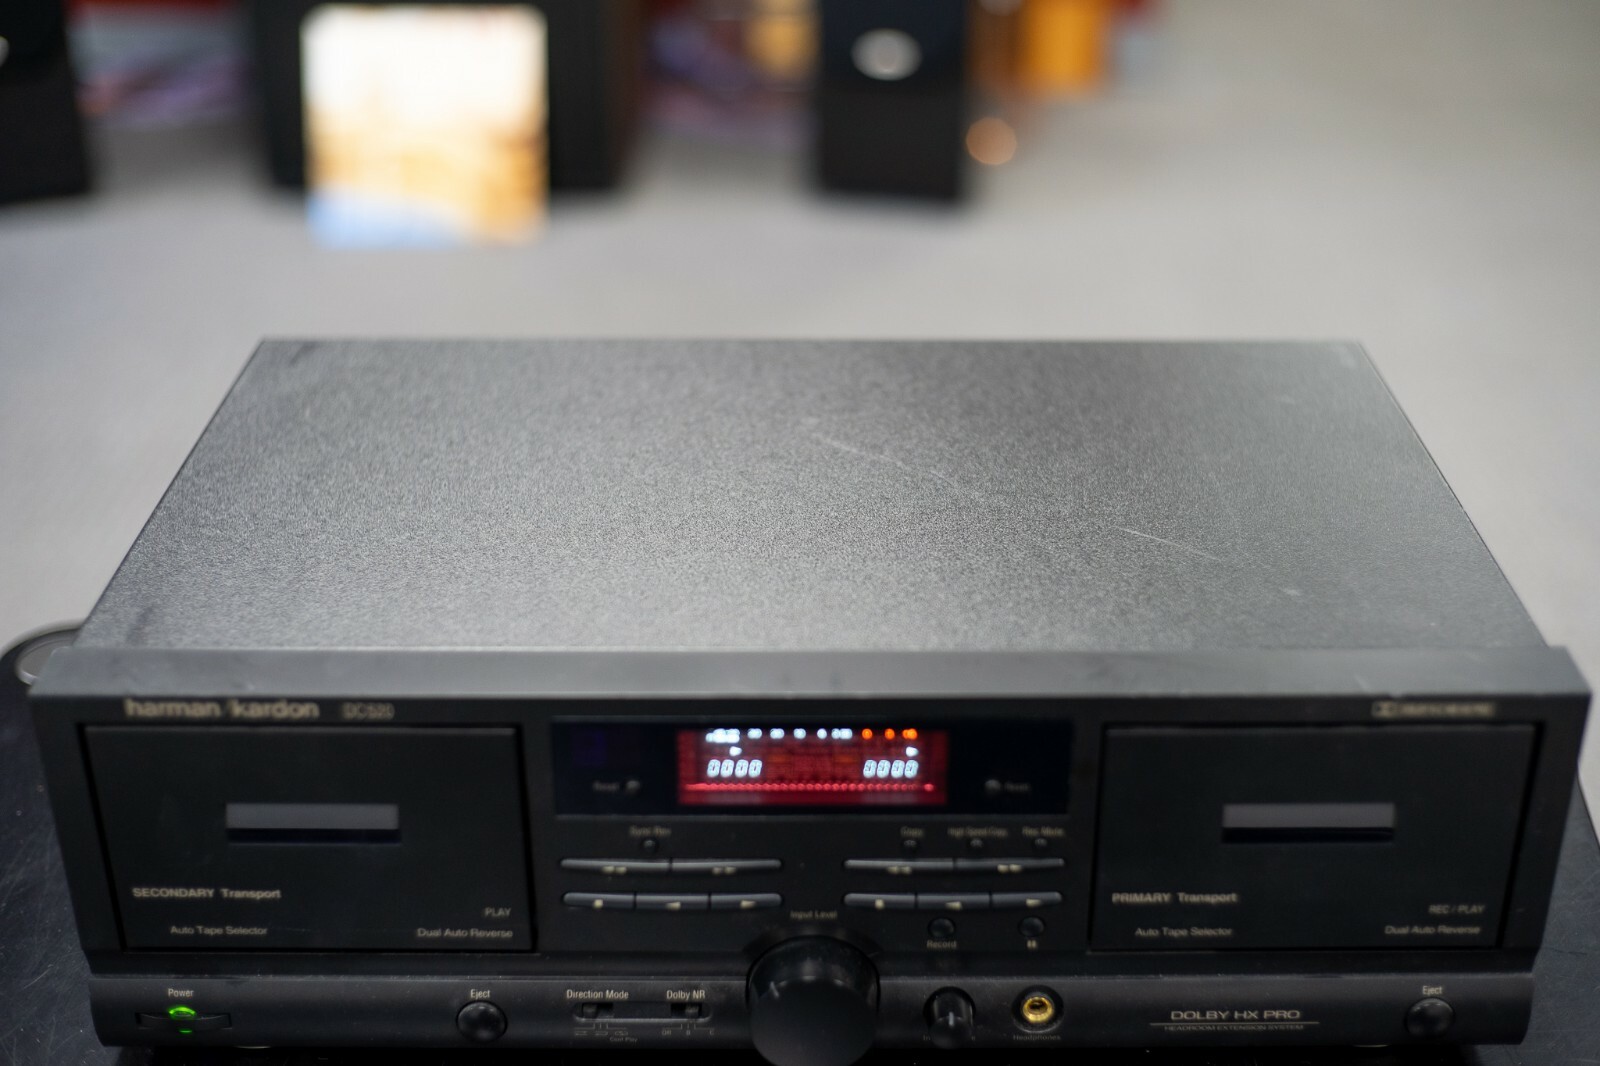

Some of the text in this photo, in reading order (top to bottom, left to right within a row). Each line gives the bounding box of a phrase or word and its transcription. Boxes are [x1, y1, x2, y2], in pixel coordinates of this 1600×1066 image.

[124, 699, 320, 719] harman kardon
[707, 759, 762, 778] 0000
[863, 759, 919, 778] 0000
[132, 888, 282, 900] SECONDARY Transport
[1112, 892, 1238, 905] PRIMARY Transport
[484, 907, 511, 917] PLAY
[1457, 905, 1485, 914] PLAY
[170, 926, 268, 936] Auto Tape Selector
[416, 927, 513, 938] Dual Auto Reverse
[1135, 927, 1233, 938] Auto Tape Selector
[1384, 925, 1481, 935] Dual Auto Reverse
[927, 939, 956, 949] Record
[168, 988, 194, 998] Power
[470, 988, 490, 999] Eject
[566, 989, 629, 999] Direction Mode
[667, 989, 705, 1000] Dolby NR
[1422, 985, 1442, 996] Eject
[1170, 1010, 1300, 1020] DOLBY HX PRO
